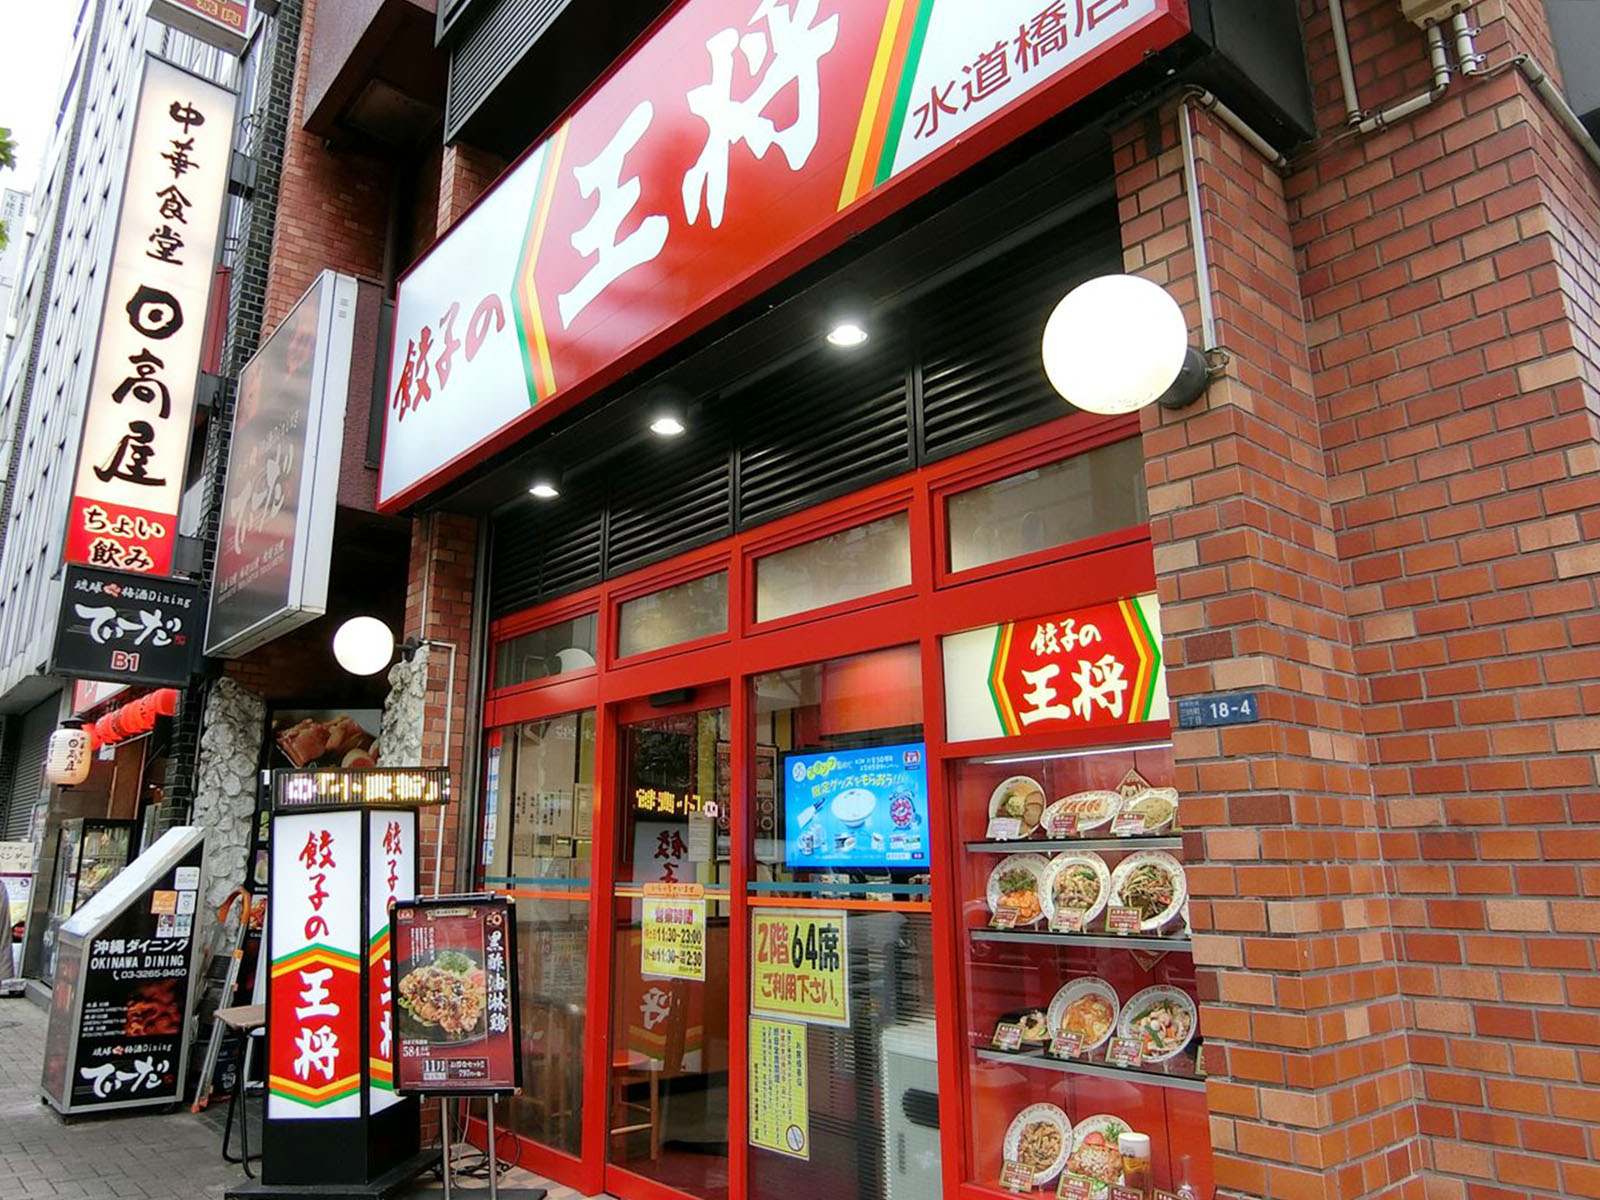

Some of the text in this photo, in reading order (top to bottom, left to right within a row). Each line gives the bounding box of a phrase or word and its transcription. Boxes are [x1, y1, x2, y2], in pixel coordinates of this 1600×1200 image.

[147, 101, 206, 267] 中華食堂
[392, 291, 505, 422] 餃子の
[83, 505, 165, 538] ちょい
[90, 538, 154, 570] 飲み
[1030, 618, 1102, 656] 餃子の
[111, 650, 140, 671] B1
[1018, 653, 1128, 727] 王将
[1209, 698, 1252, 720] 18-4
[90, 953, 185, 970] OKINAWA DINING
[293, 830, 341, 1081] 餃子の 王将
